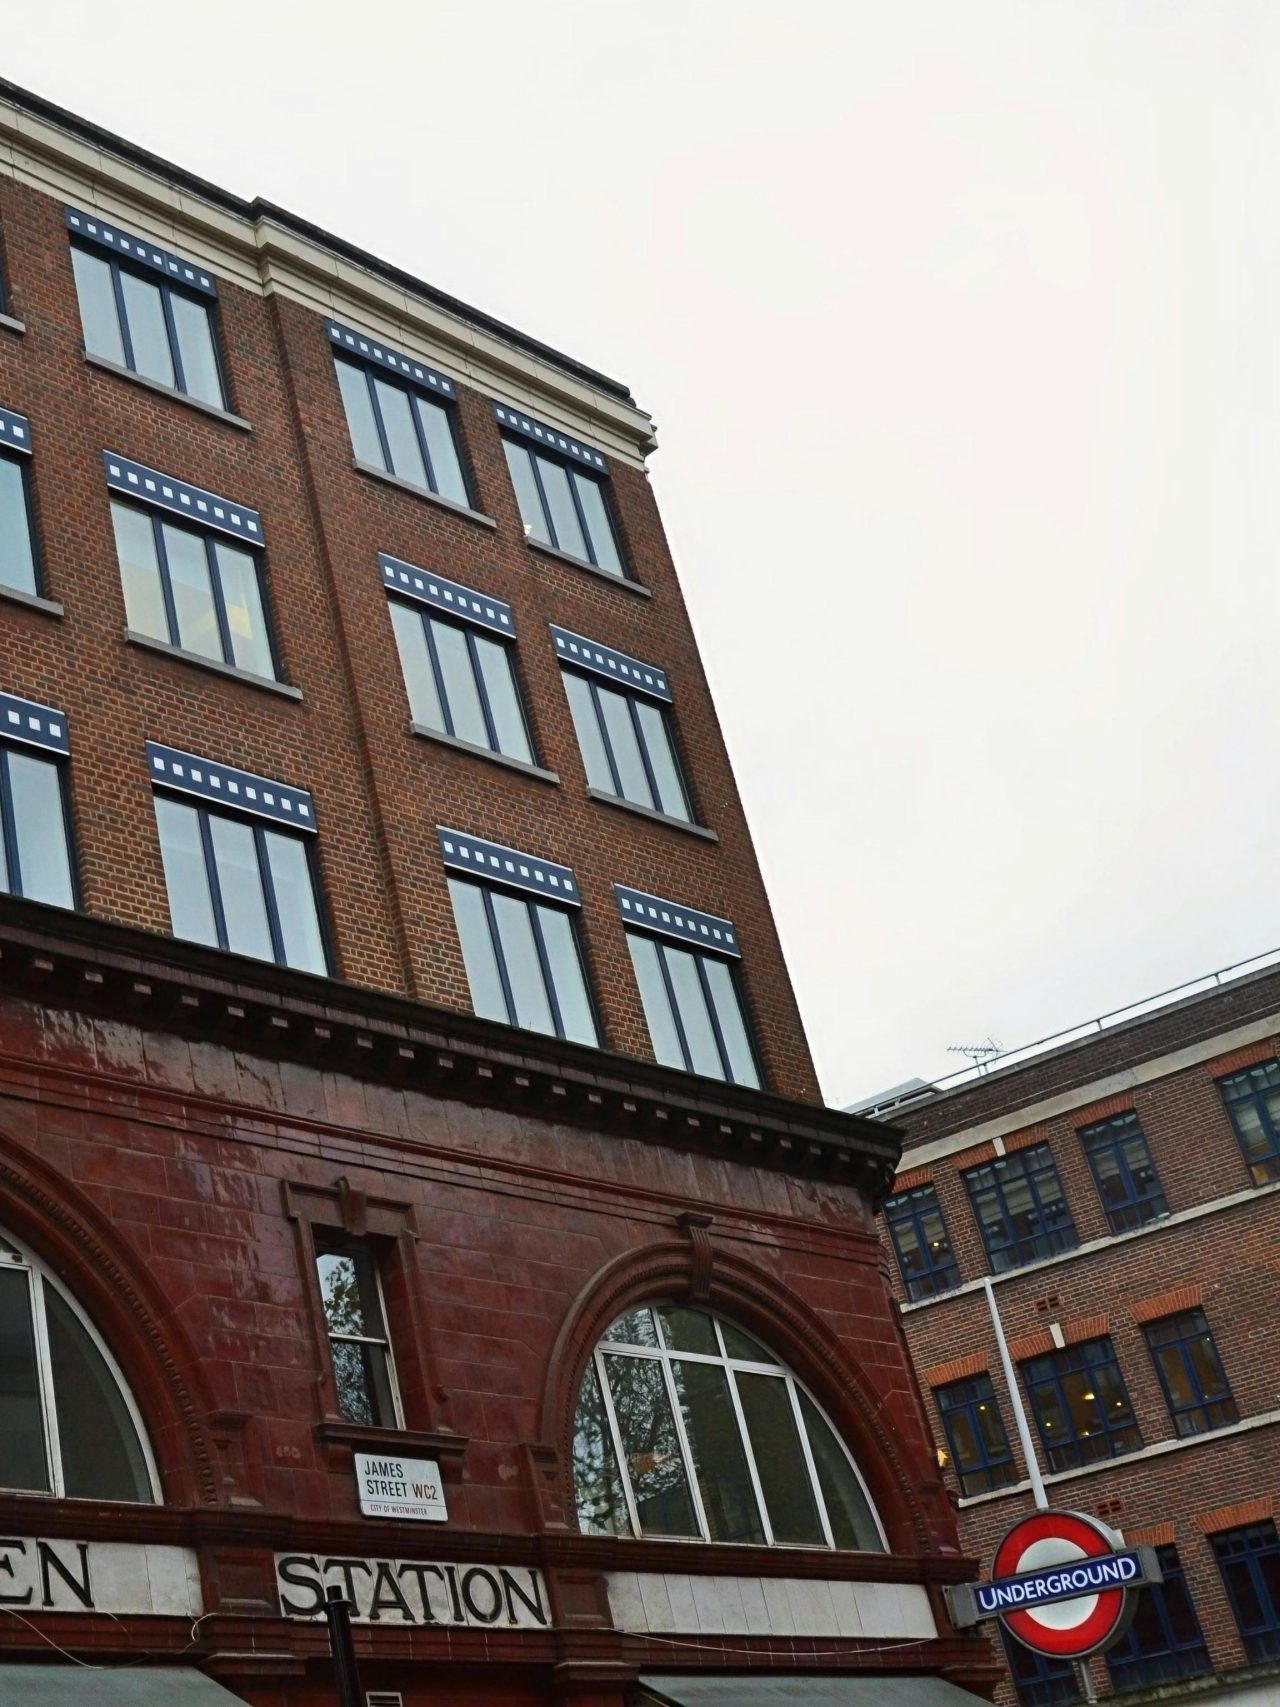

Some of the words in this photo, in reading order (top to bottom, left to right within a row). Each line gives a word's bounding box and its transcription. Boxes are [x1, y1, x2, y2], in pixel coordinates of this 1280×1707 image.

[364, 1461, 404, 1479] JAMES
[366, 1479, 408, 1498] STREET
[412, 1483, 438, 1500] WC2
[370, 1504, 382, 1512] CITY
[384, 1505, 390, 1513] OF
[392, 1506, 428, 1516] WESTMINSTER
[278, 1556, 547, 1625] STATION
[979, 1557, 1137, 1610] UNDERGROUND
